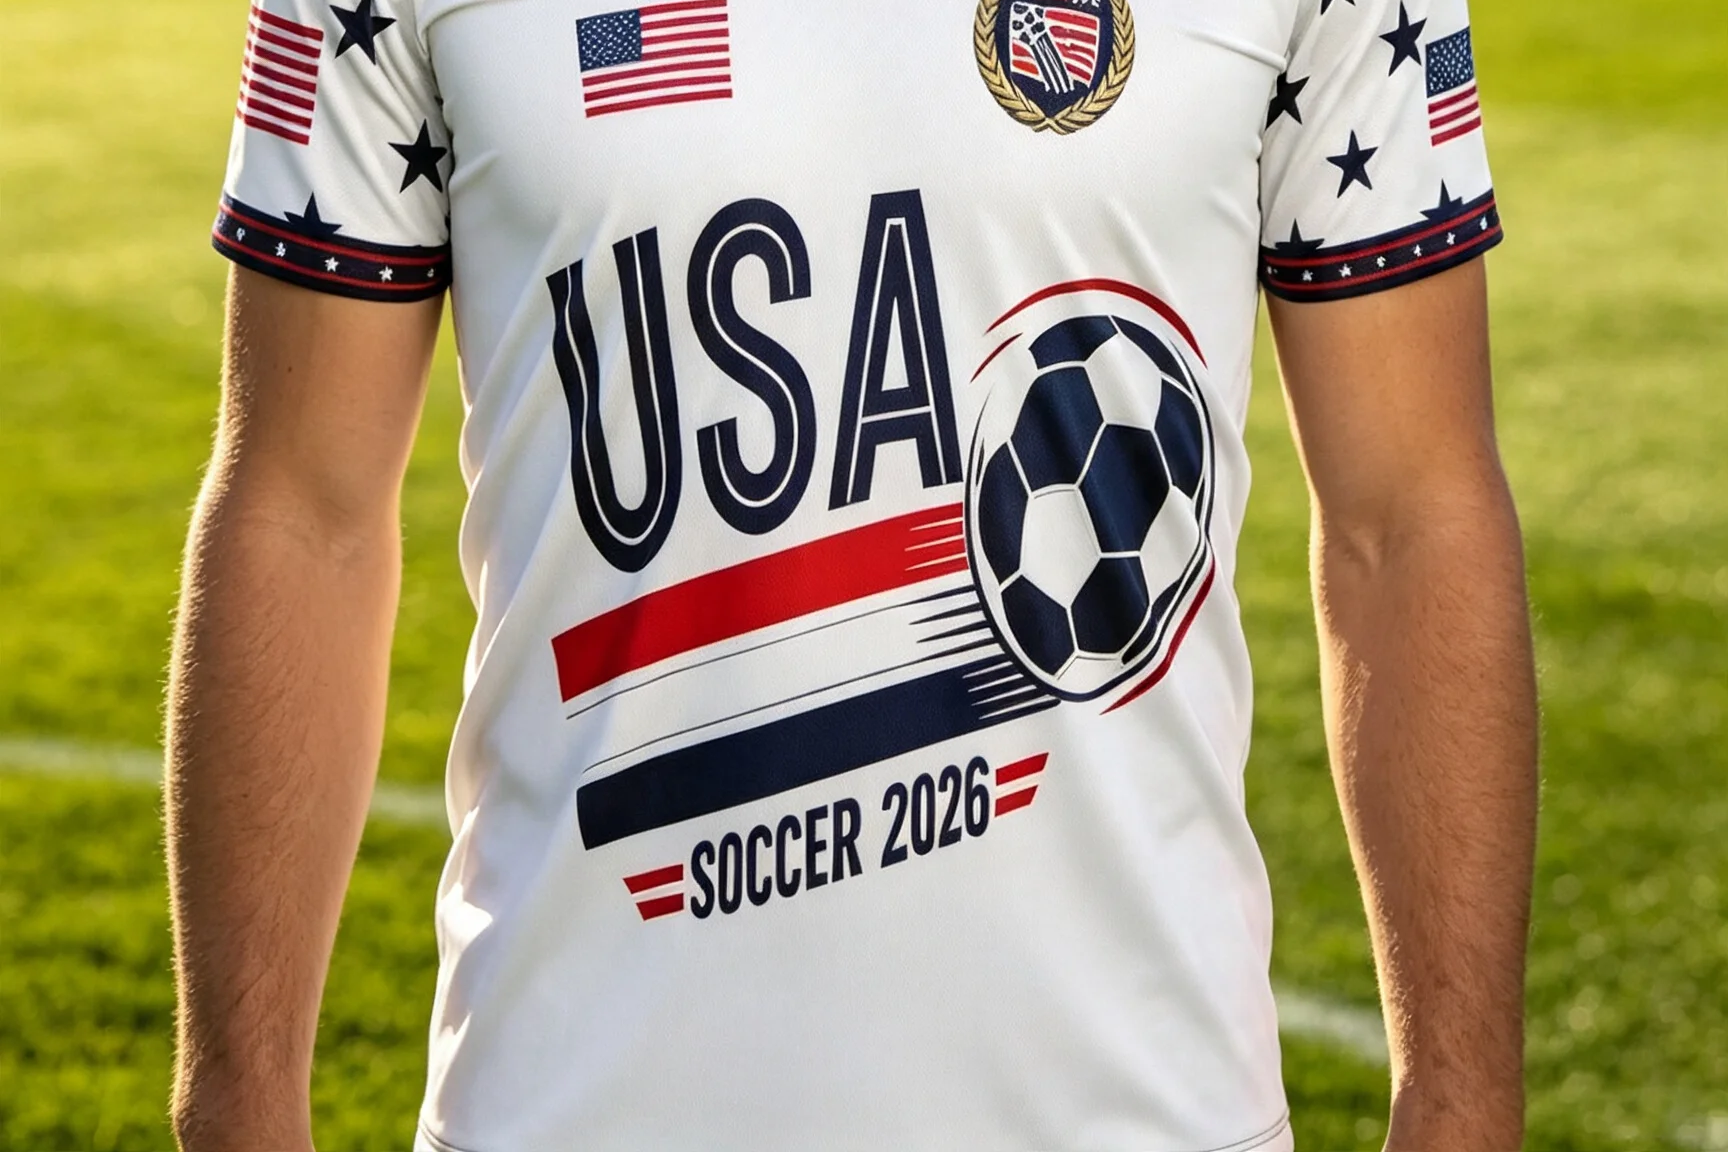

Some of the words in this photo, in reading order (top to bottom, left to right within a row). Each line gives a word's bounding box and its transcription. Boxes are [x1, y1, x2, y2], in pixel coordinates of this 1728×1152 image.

[545, 188, 964, 574] USA
[690, 796, 863, 919] SOCCER
[881, 755, 990, 869] 2026
